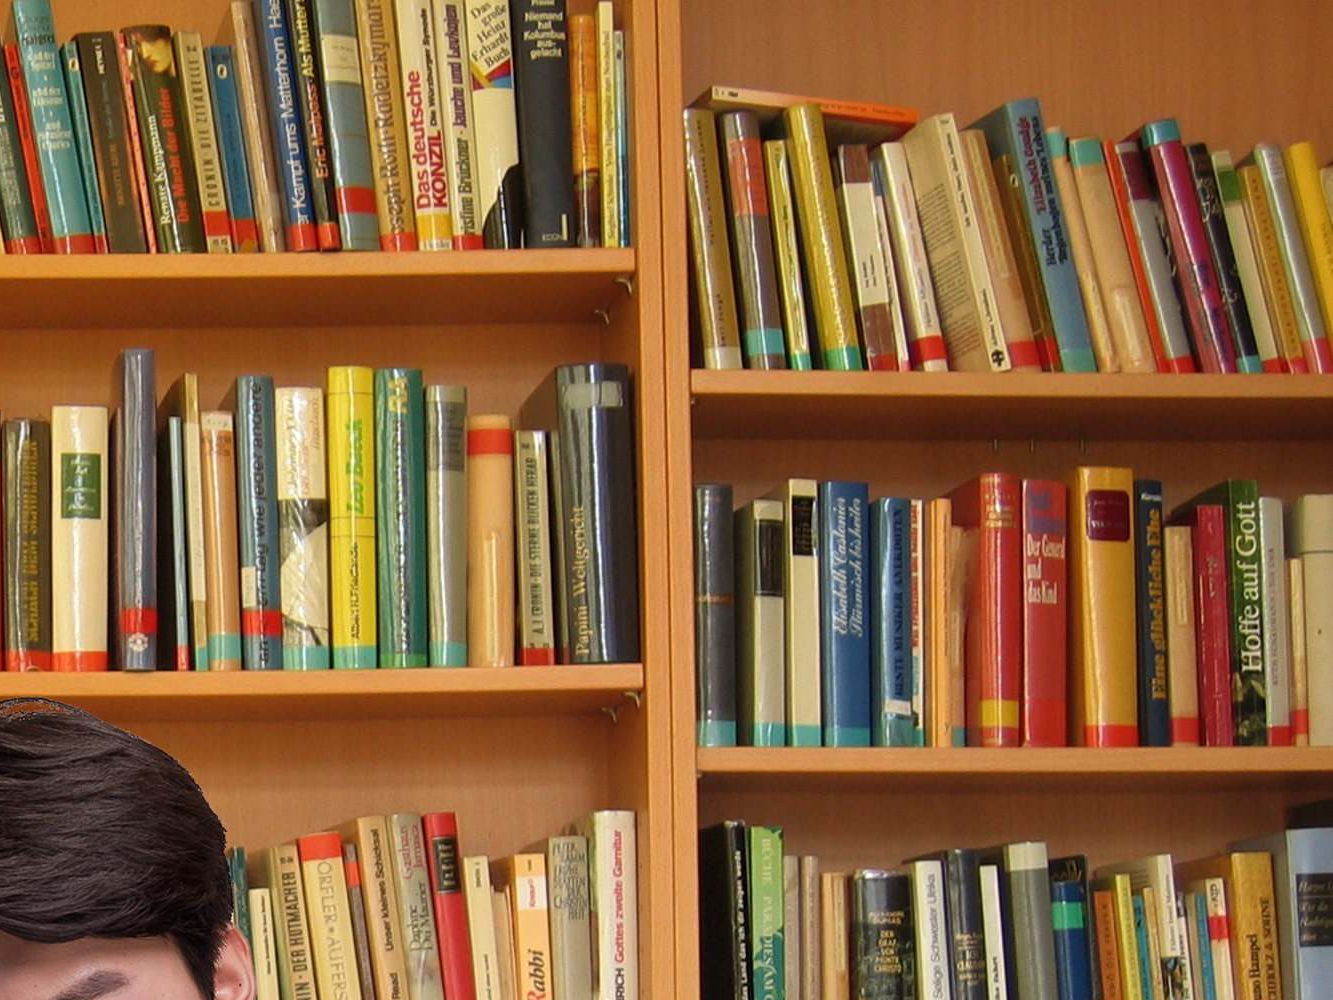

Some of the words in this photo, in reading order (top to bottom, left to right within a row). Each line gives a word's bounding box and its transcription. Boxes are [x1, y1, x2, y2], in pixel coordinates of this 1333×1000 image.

[295, 5, 312, 52] Mutter
[419, 8, 431, 46] Synode
[470, 2, 492, 19] Das
[524, 11, 563, 22] Niemand
[538, 20, 552, 30] hat
[472, 32, 510, 62] Erhardt
[476, 21, 508, 43] Heinz
[301, 54, 316, 77] Als
[484, 47, 510, 68] Buch
[159, 87, 175, 128] Bilder
[186, 58, 207, 124] ZITADELLE
[405, 70, 428, 159] deutsche
[430, 110, 439, 127] Die
[146, 114, 166, 182] Kampmann
[165, 129, 179, 152] der
[198, 129, 211, 148] DIE
[1017, 116, 1035, 157] Goudge
[1030, 116, 1045, 155] Lebens
[167, 154, 186, 197] Macht
[202, 157, 221, 207] CRONIN
[315, 148, 329, 178] Eric
[427, 130, 448, 209] KONZIL
[154, 183, 171, 225] Renate
[415, 169, 433, 209] Das
[1025, 160, 1047, 215] Elizabeth
[176, 200, 189, 223] Die
[1040, 228, 1057, 267] Herder
[250, 382, 263, 448] andere
[345, 418, 363, 478] Baeck
[252, 454, 268, 501] jeder
[345, 482, 364, 514] Leo
[254, 506, 266, 538] wie
[1147, 508, 1161, 546] Ehe
[1234, 500, 1258, 557] Gott
[570, 505, 590, 597] Weltgericht
[1027, 581, 1041, 605] das
[1236, 560, 1260, 600] auf
[573, 605, 594, 655] Papini
[1239, 604, 1264, 672] Hoffe
[1152, 654, 1167, 699] Eine
[369, 827, 388, 879] Schicksal
[734, 850, 742, 877] werde
[281, 871, 305, 946] HUTMACHER
[376, 881, 391, 919] kleines
[613, 880, 625, 920] zweite
[736, 911, 745, 924] dir
[382, 920, 395, 952] Unser
[406, 903, 425, 951] Daphne
[420, 929, 433, 951] Du
[612, 922, 626, 963] Gottes
[736, 926, 746, 940] ich
[288, 948, 308, 973] DER
[738, 942, 747, 959] das
[1246, 933, 1261, 978] Hampel
[388, 972, 403, 1000] Read
[738, 961, 748, 984] Land
